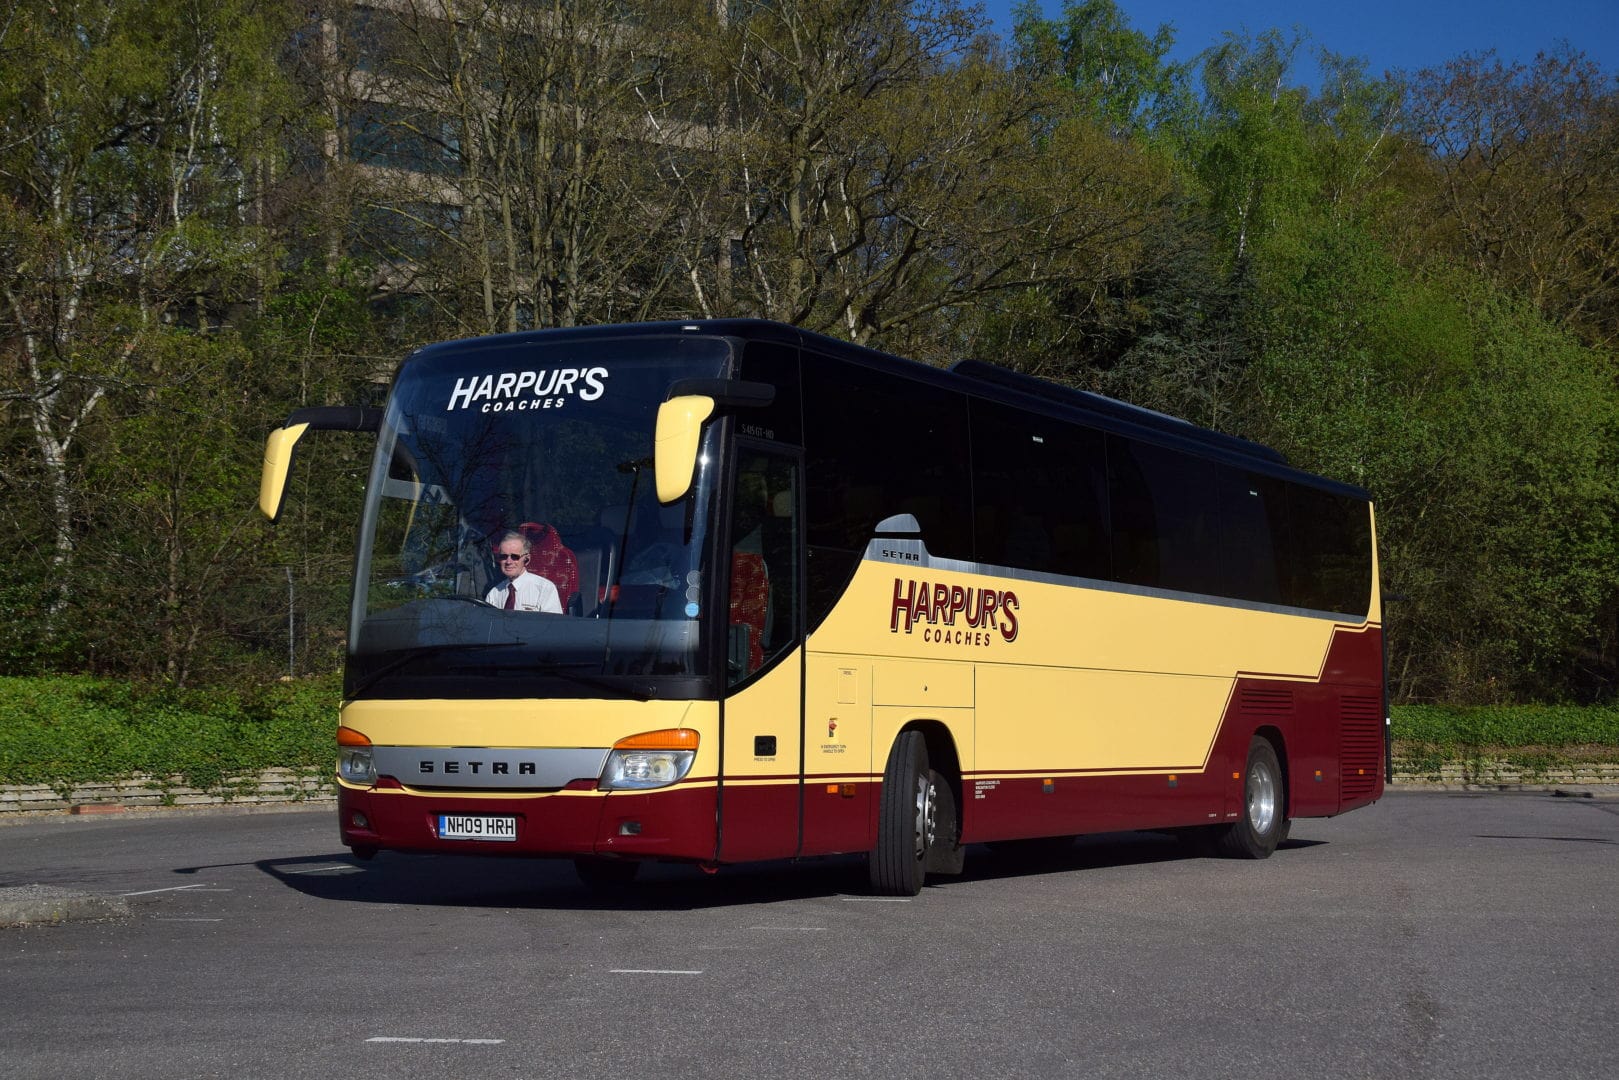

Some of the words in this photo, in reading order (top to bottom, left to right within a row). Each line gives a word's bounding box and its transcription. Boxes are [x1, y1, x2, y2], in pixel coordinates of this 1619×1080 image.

[447, 367, 608, 410] HARPUR'S
[482, 398, 565, 413] COACHES
[882, 549, 919, 561] SETRA
[890, 578, 1019, 643] HARPUR'S
[924, 628, 990, 647] COACHES
[420, 761, 536, 775] SETRA
[447, 817, 482, 834] NH09
[486, 818, 514, 835] HRH
